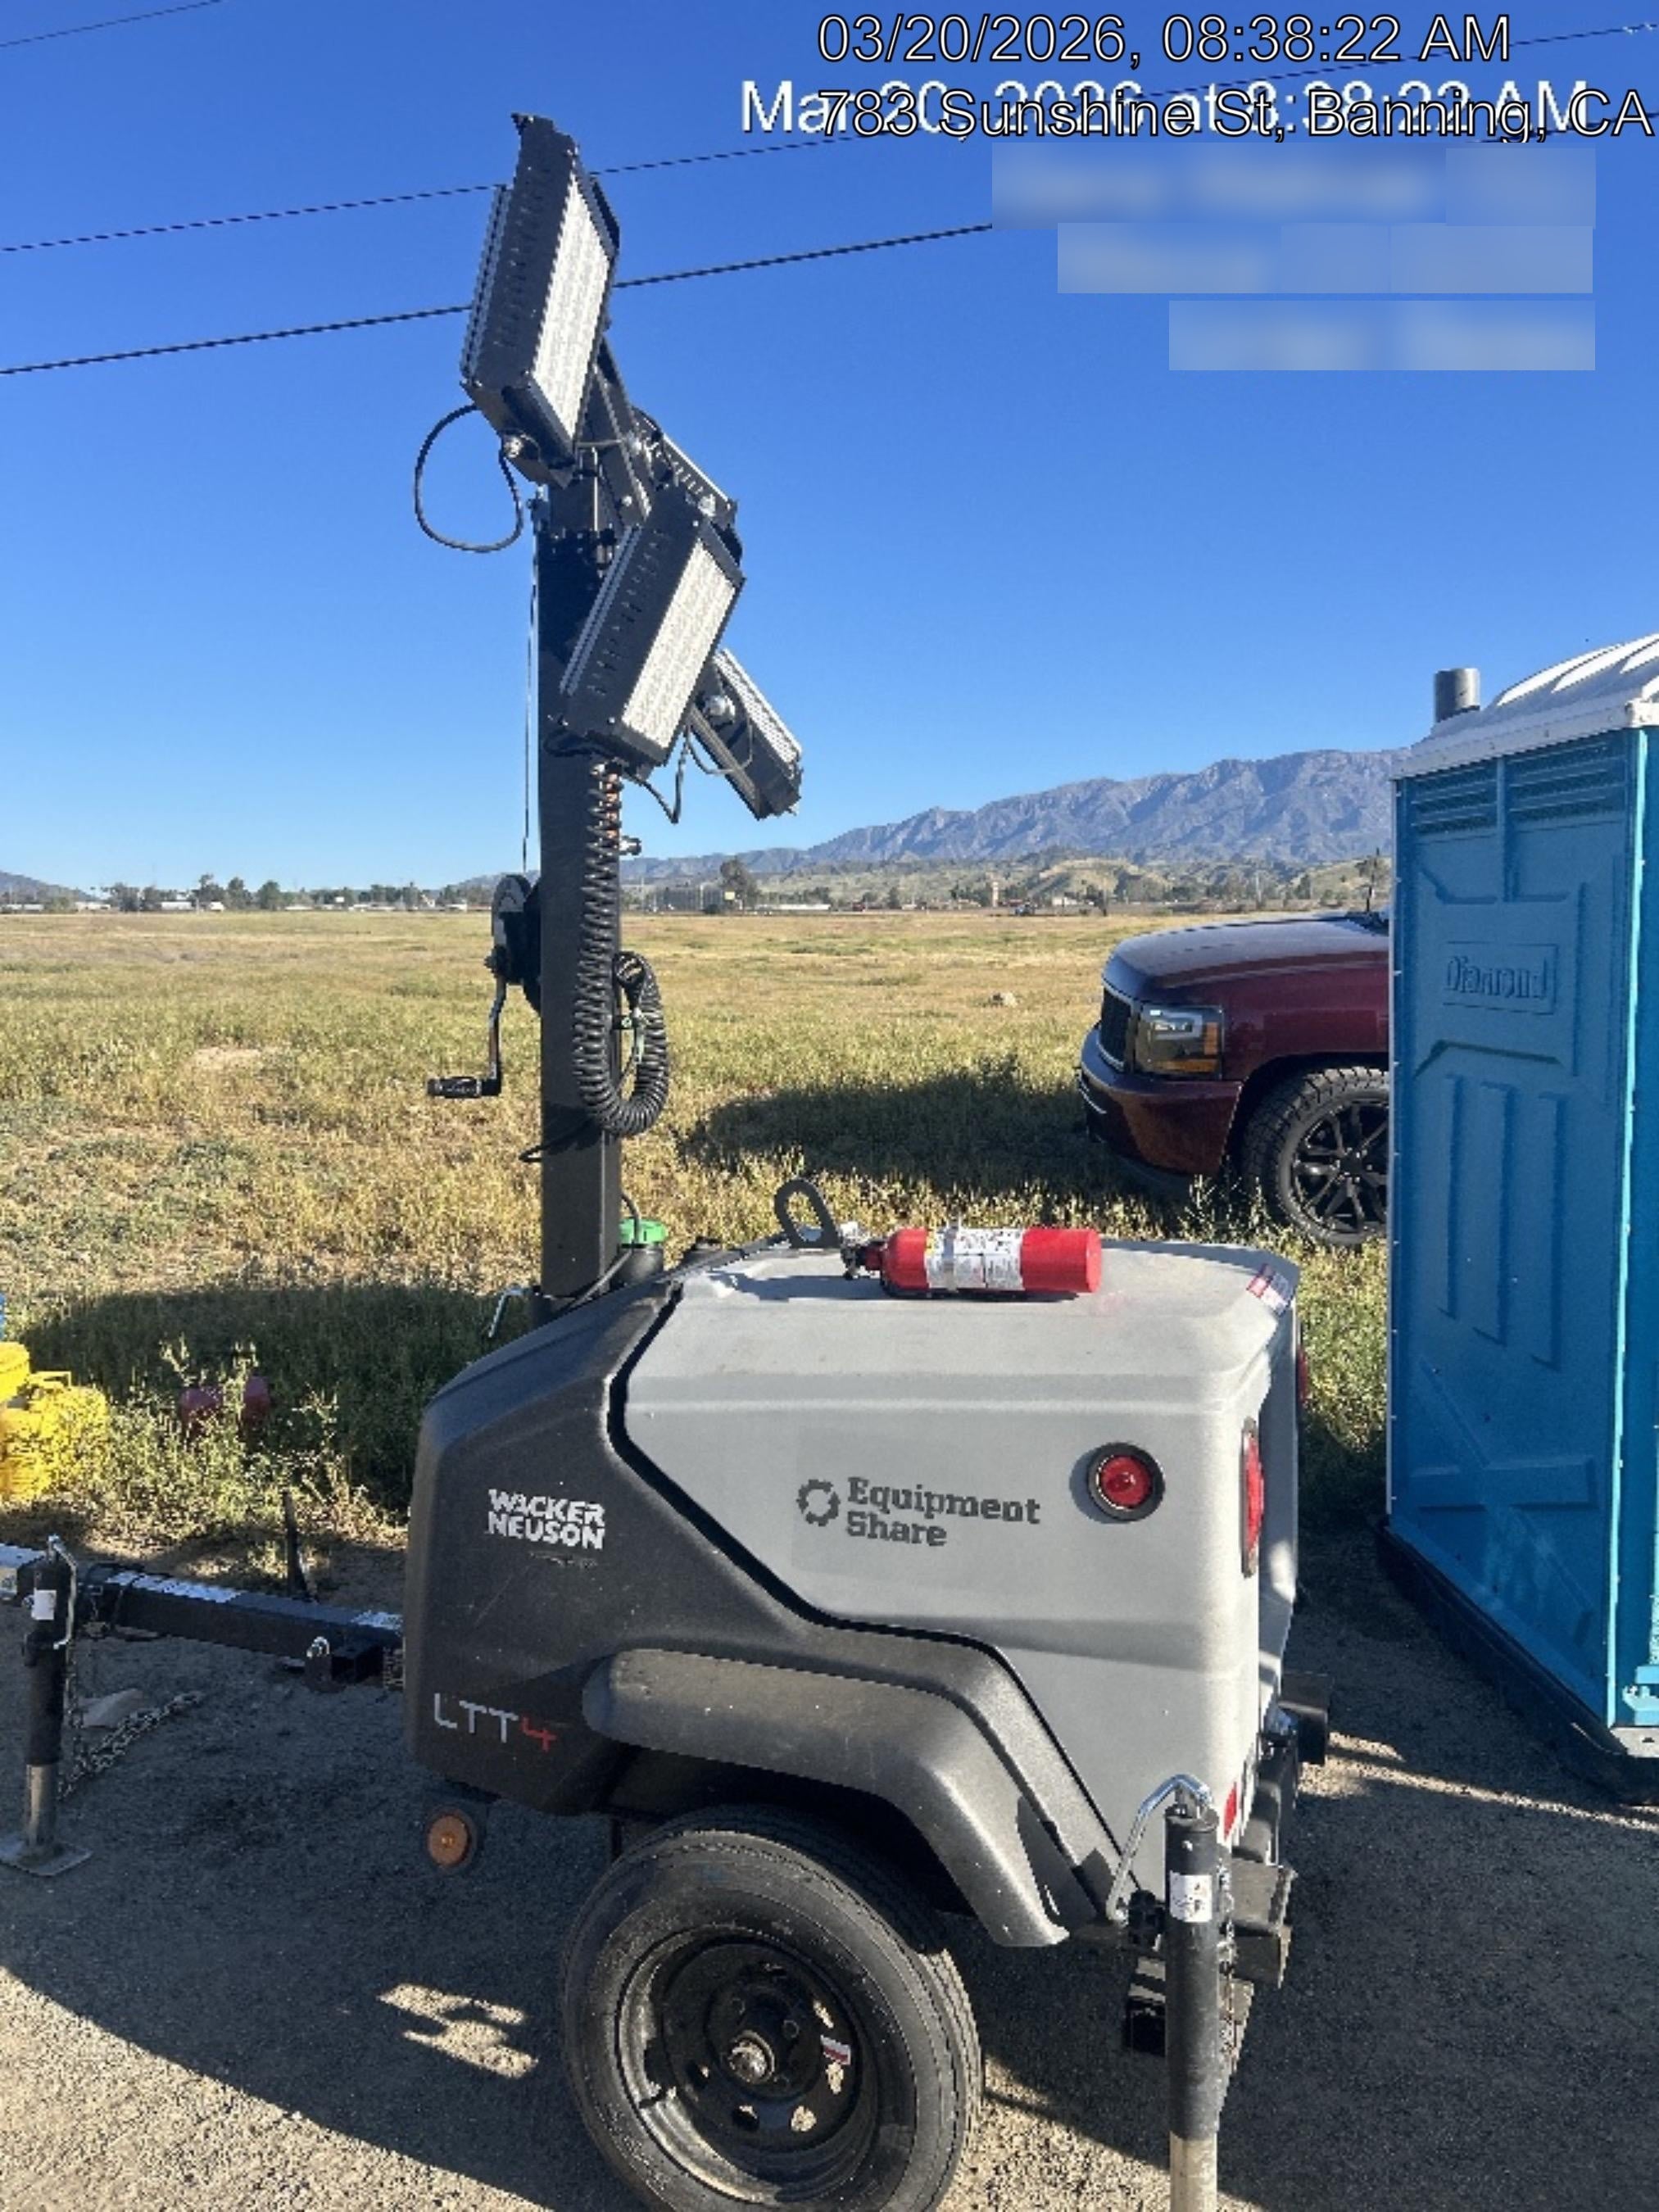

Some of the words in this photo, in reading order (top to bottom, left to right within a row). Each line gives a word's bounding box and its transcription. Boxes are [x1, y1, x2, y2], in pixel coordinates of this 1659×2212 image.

[488, 1489, 605, 1527] WACKER
[847, 1476, 1040, 1525] Equipment
[487, 1511, 605, 1549] NEUSON
[846, 1510, 948, 1546] Share
[434, 1693, 557, 1752] LTT4
